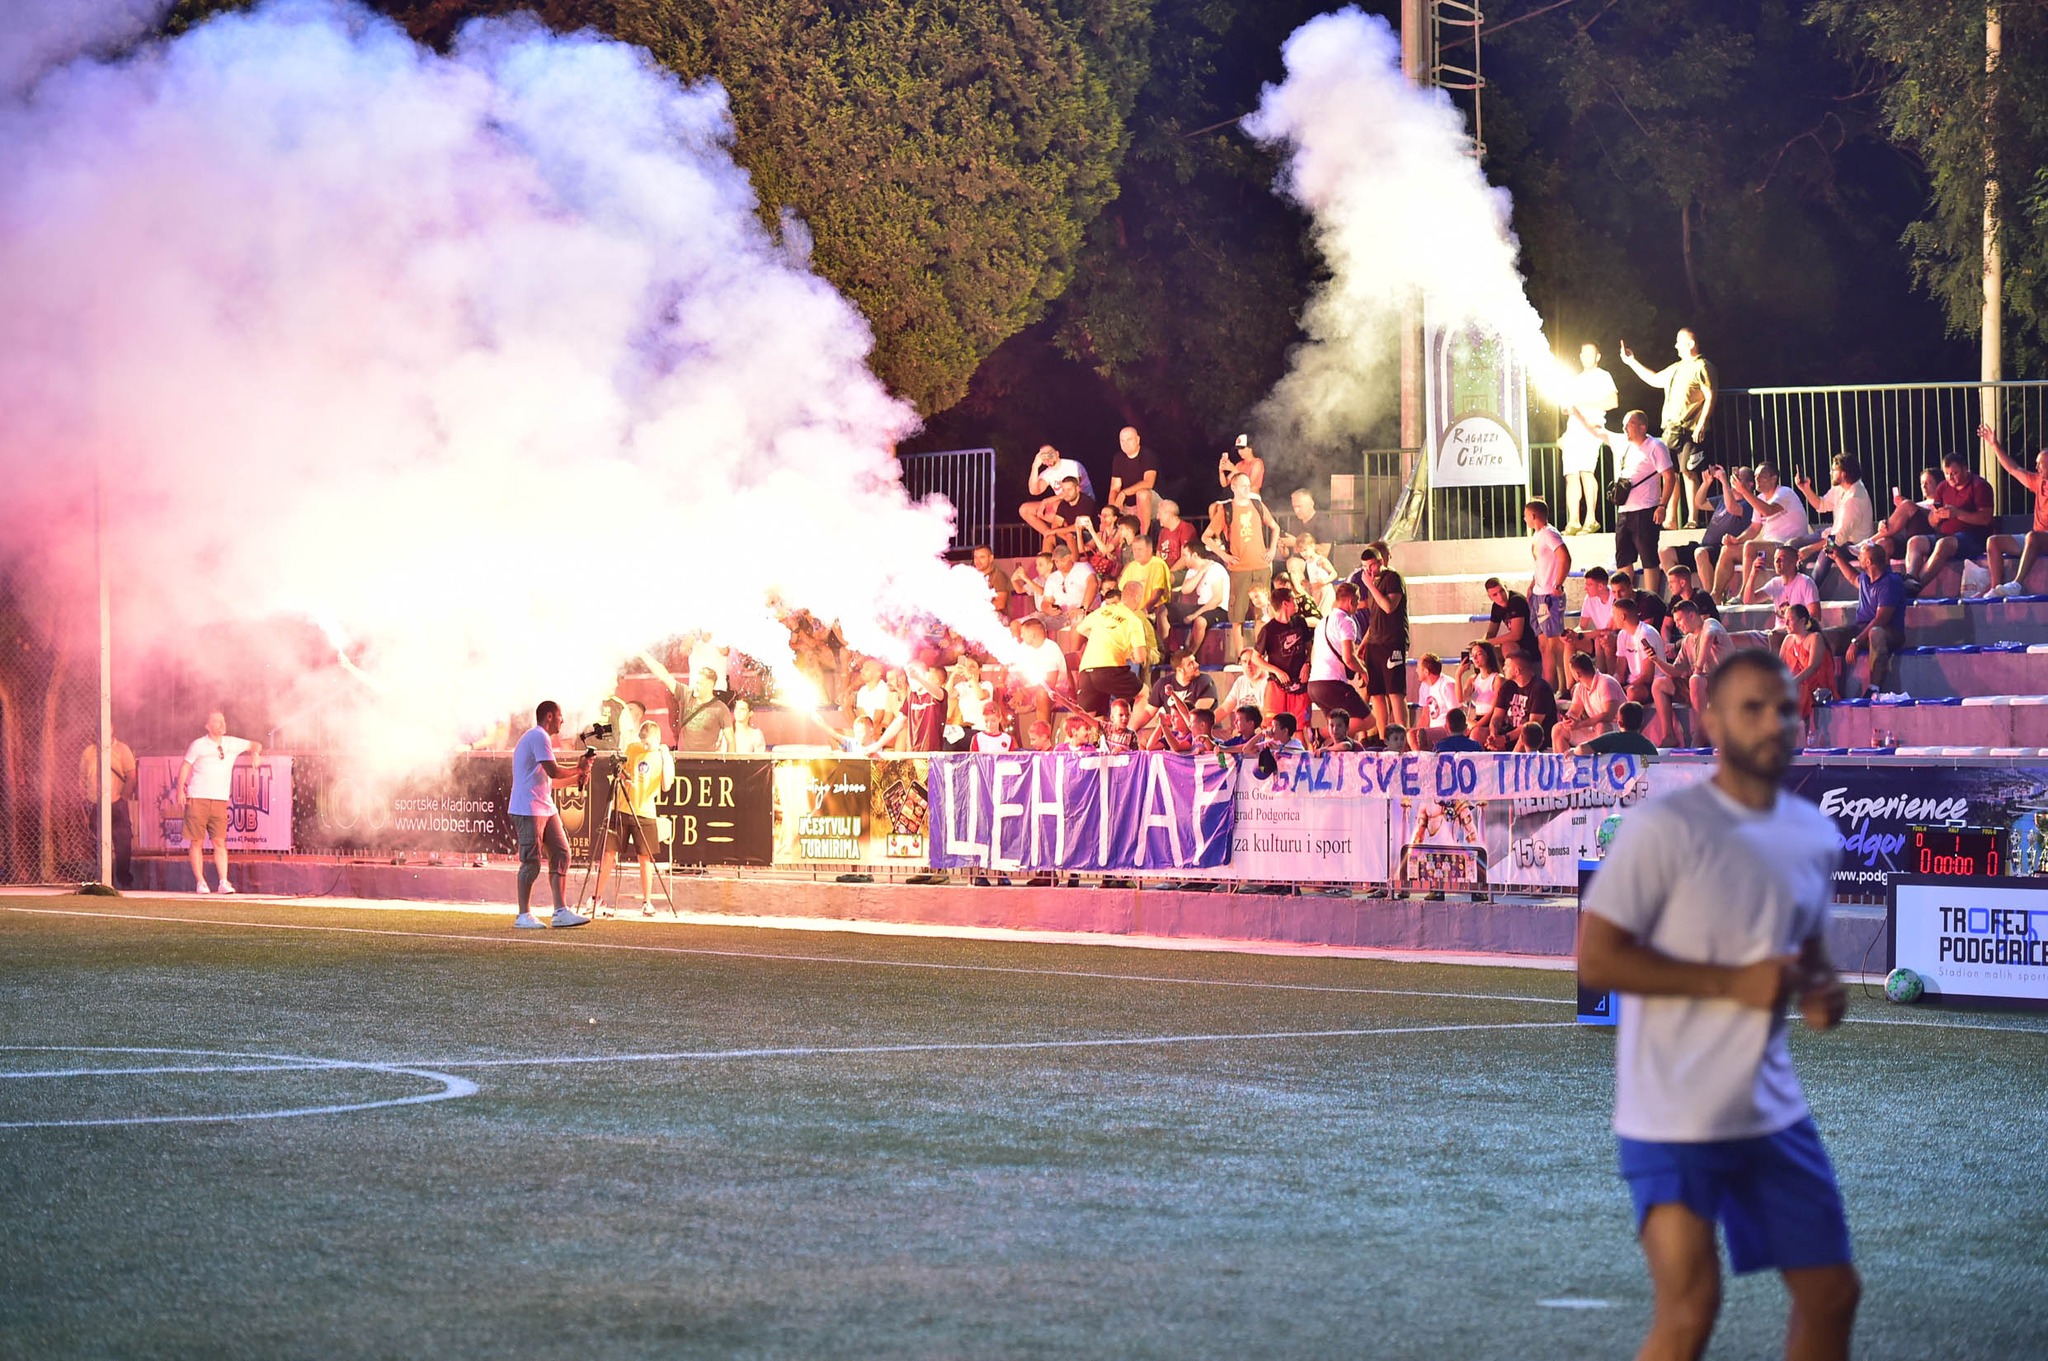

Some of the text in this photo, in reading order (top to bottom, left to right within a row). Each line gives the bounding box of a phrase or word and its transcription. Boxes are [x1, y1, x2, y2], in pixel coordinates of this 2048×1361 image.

[1358, 756, 1420, 796] SVE
[1436, 754, 1477, 796] DO
[230, 764, 273, 815] ORT
[1234, 790, 1250, 800] rna
[395, 797, 495, 813] sportske kladionice
[1256, 807, 1300, 824] Podgorica
[1819, 787, 1969, 830] Experience
[395, 815, 495, 834] www.lobbet.me
[1571, 815, 1587, 826] uzmi
[801, 838, 860, 860] TURNIRIMA
[1234, 838, 1249, 852] za
[1254, 833, 1302, 853] kulturu
[1316, 836, 1352, 858] sport
[1920, 848, 1998, 877] 0 00:00 0
[1939, 907, 2028, 936] TROFEJ
[1939, 966, 1979, 978] Stadion
[1984, 969, 2012, 980] malih
